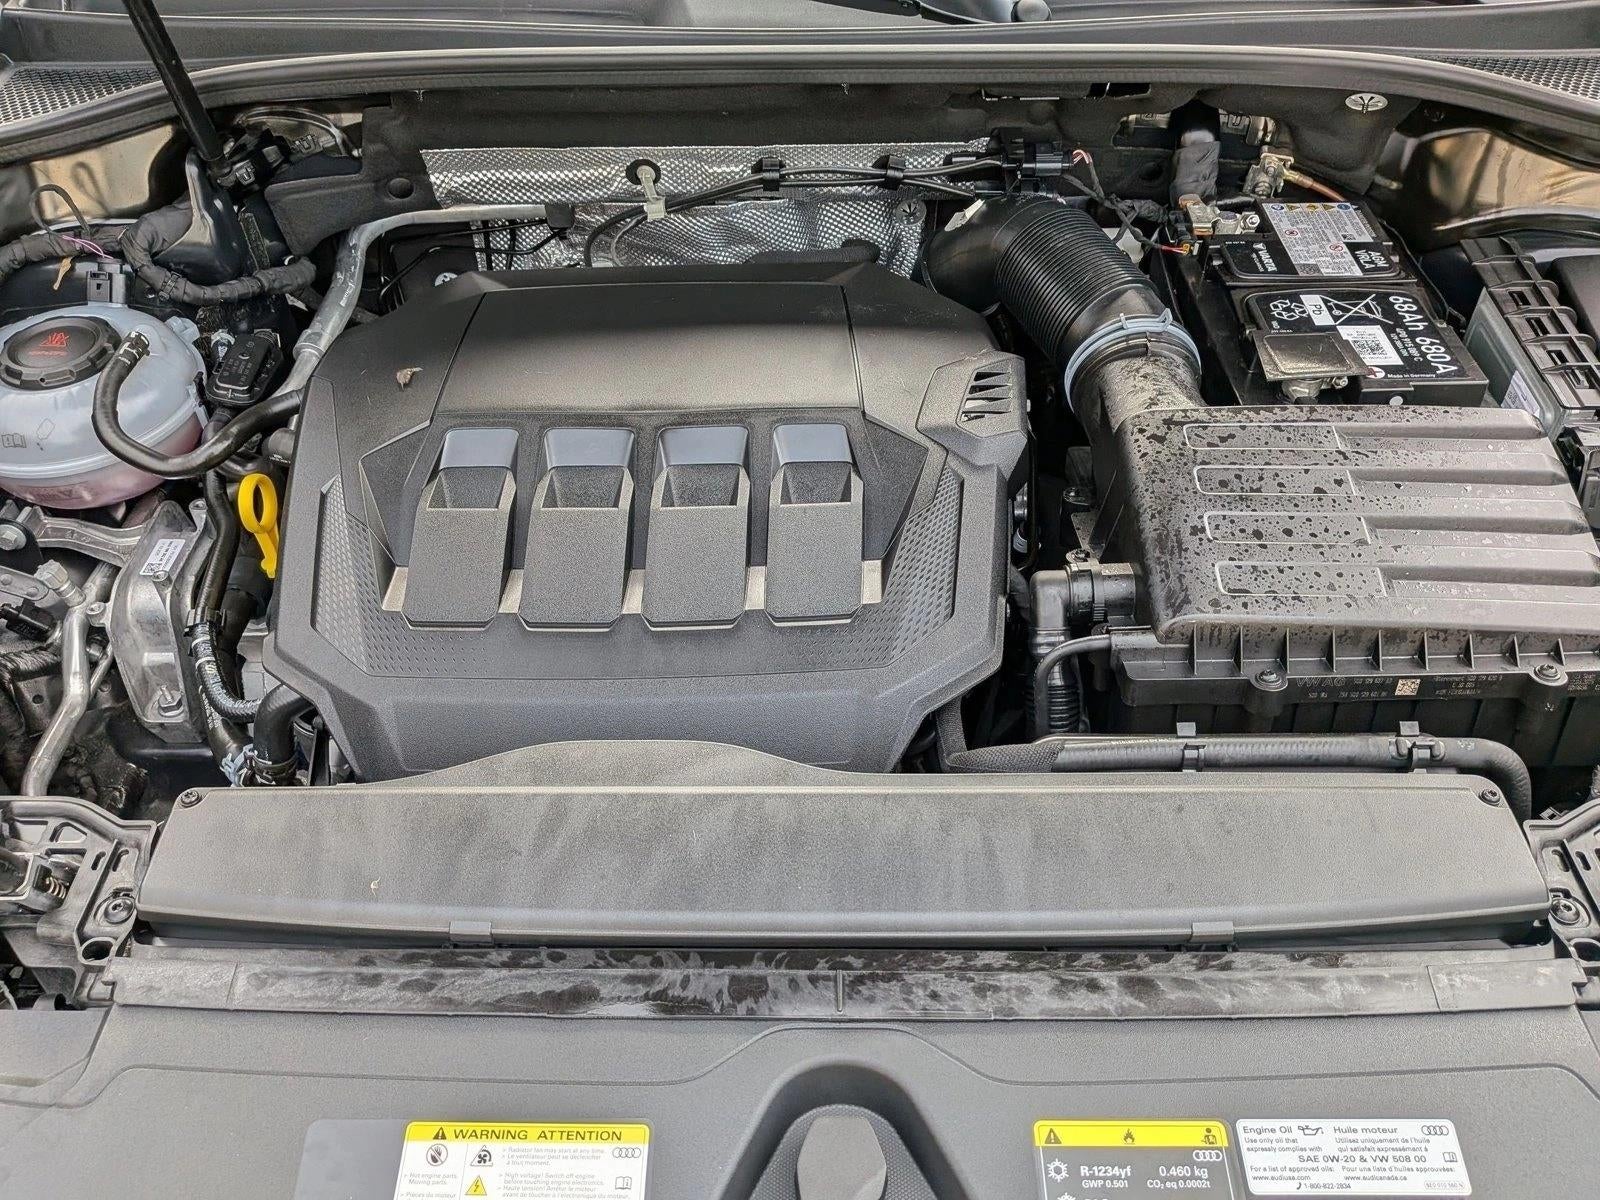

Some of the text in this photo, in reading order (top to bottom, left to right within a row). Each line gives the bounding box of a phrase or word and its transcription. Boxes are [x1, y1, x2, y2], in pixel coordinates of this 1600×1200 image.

[1258, 250, 1277, 272] VARTA
[1355, 249, 1376, 269] VRLA
[1368, 251, 1390, 267] AGM
[1309, 303, 1324, 315] Pb
[1388, 295, 1458, 374] 68Ah 680A
[453, 1129, 622, 1141] WARNING ATTENTION
[1243, 1125, 1293, 1136] Engine Oil
[1333, 1126, 1358, 1134] Huile
[1360, 1137, 1399, 1145] uniquement
[1278, 1145, 1307, 1153] complies
[1298, 1155, 1427, 1163] SAE 0W-20 & VW 508 00
[1080, 1165, 1208, 1179] R-1234yf 0.460 kg
[1082, 1180, 1129, 1188] GWP 0.501
[1166, 1181, 1178, 1189] eq
[1178, 1180, 1211, 1188] 0.0002t
